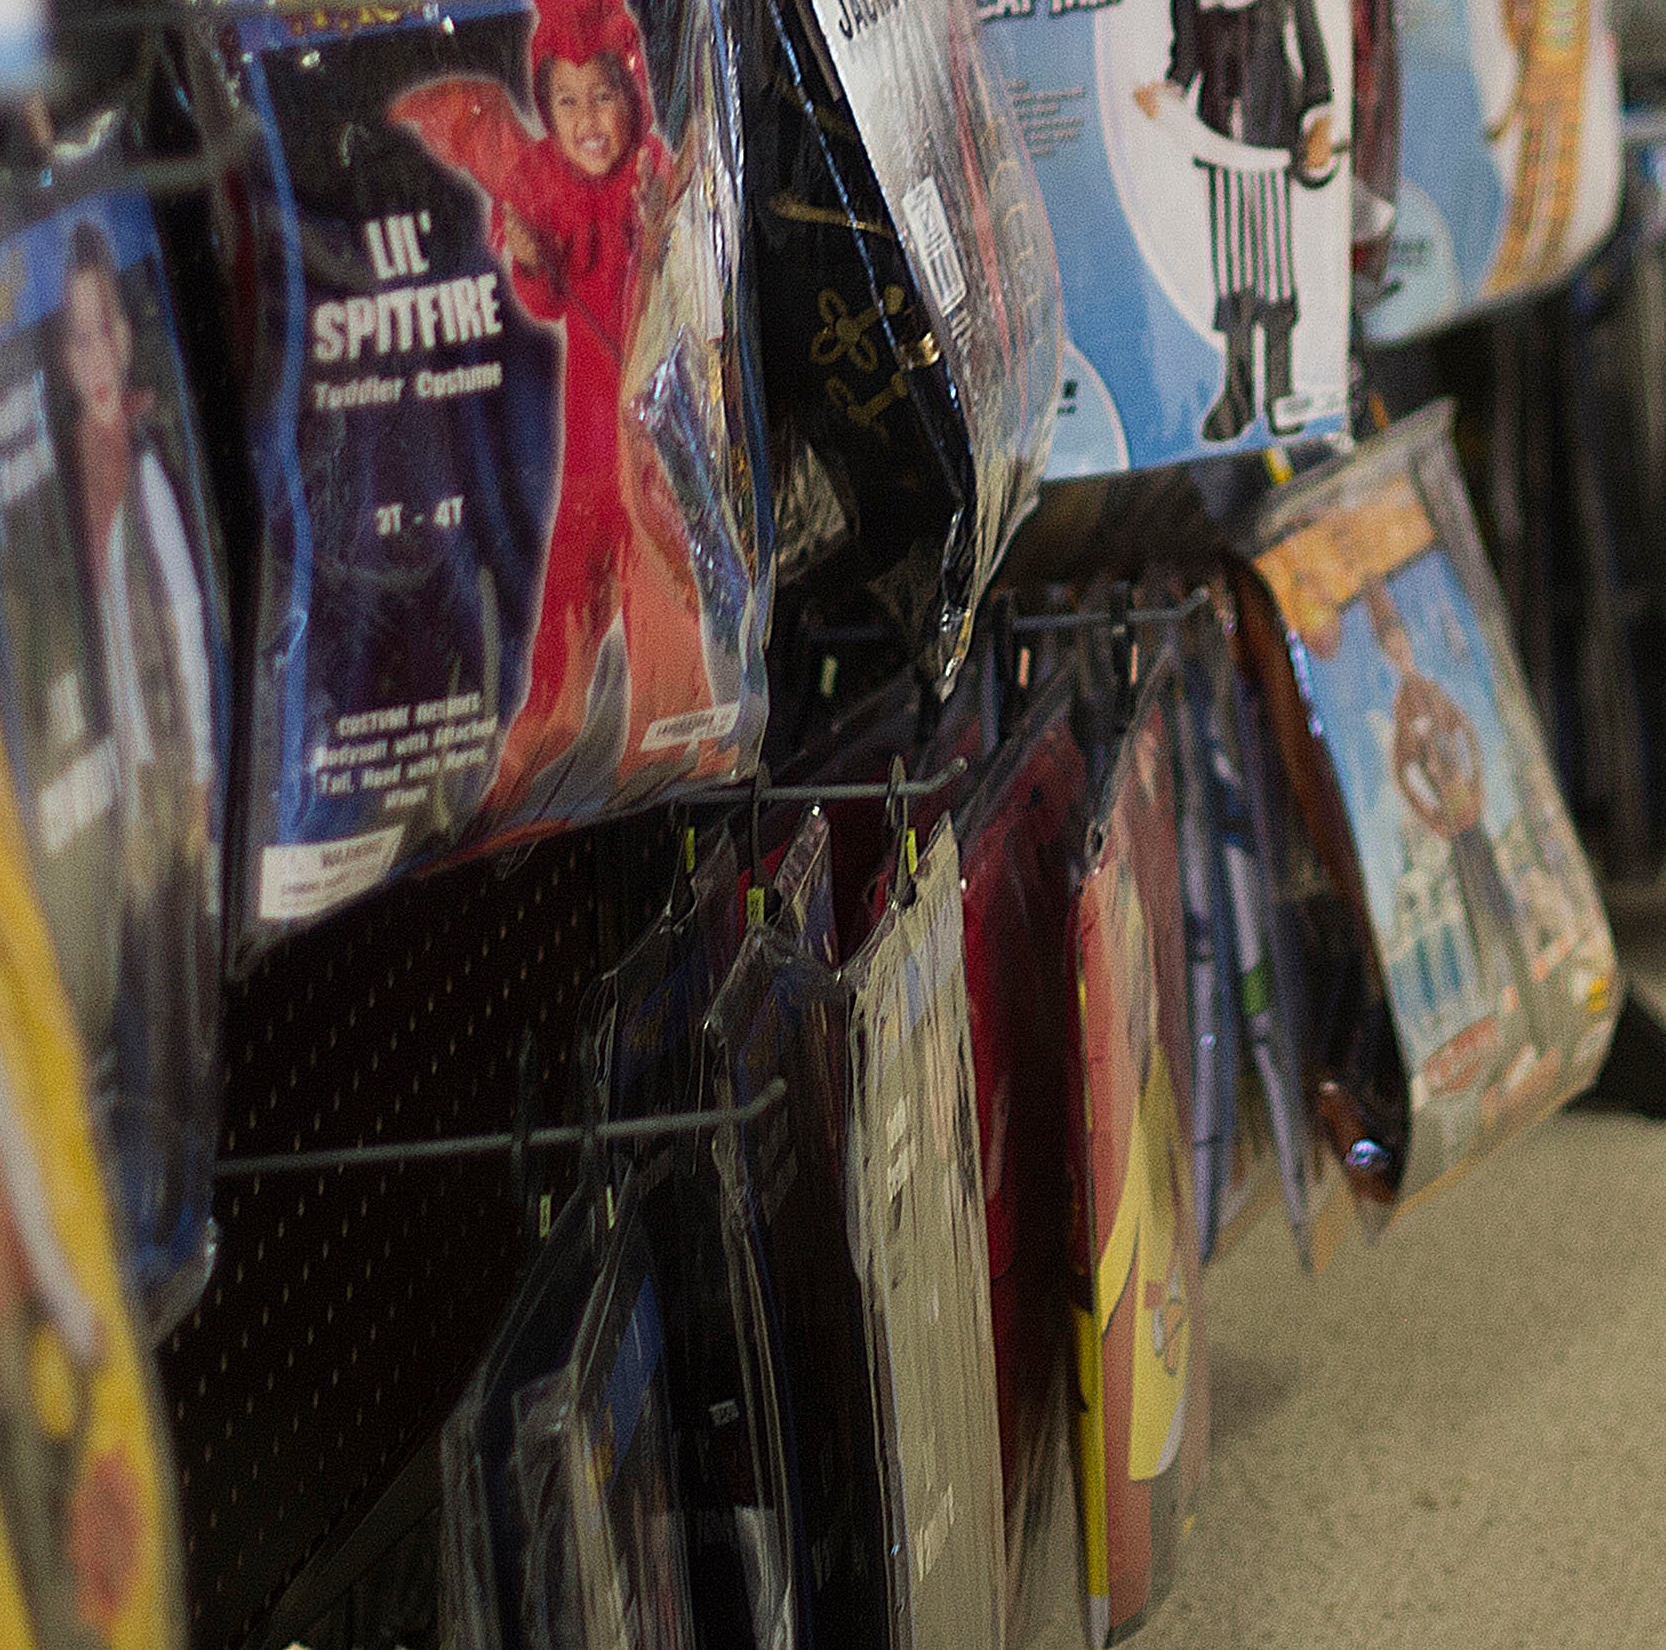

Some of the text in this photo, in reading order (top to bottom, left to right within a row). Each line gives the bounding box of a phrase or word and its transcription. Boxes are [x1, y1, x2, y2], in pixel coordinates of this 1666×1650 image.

[364, 208, 432, 281] LIL'
[313, 272, 504, 362] SPITFIRE
[314, 360, 504, 410] Toddler Costume
[434, 495, 465, 529] 4T
